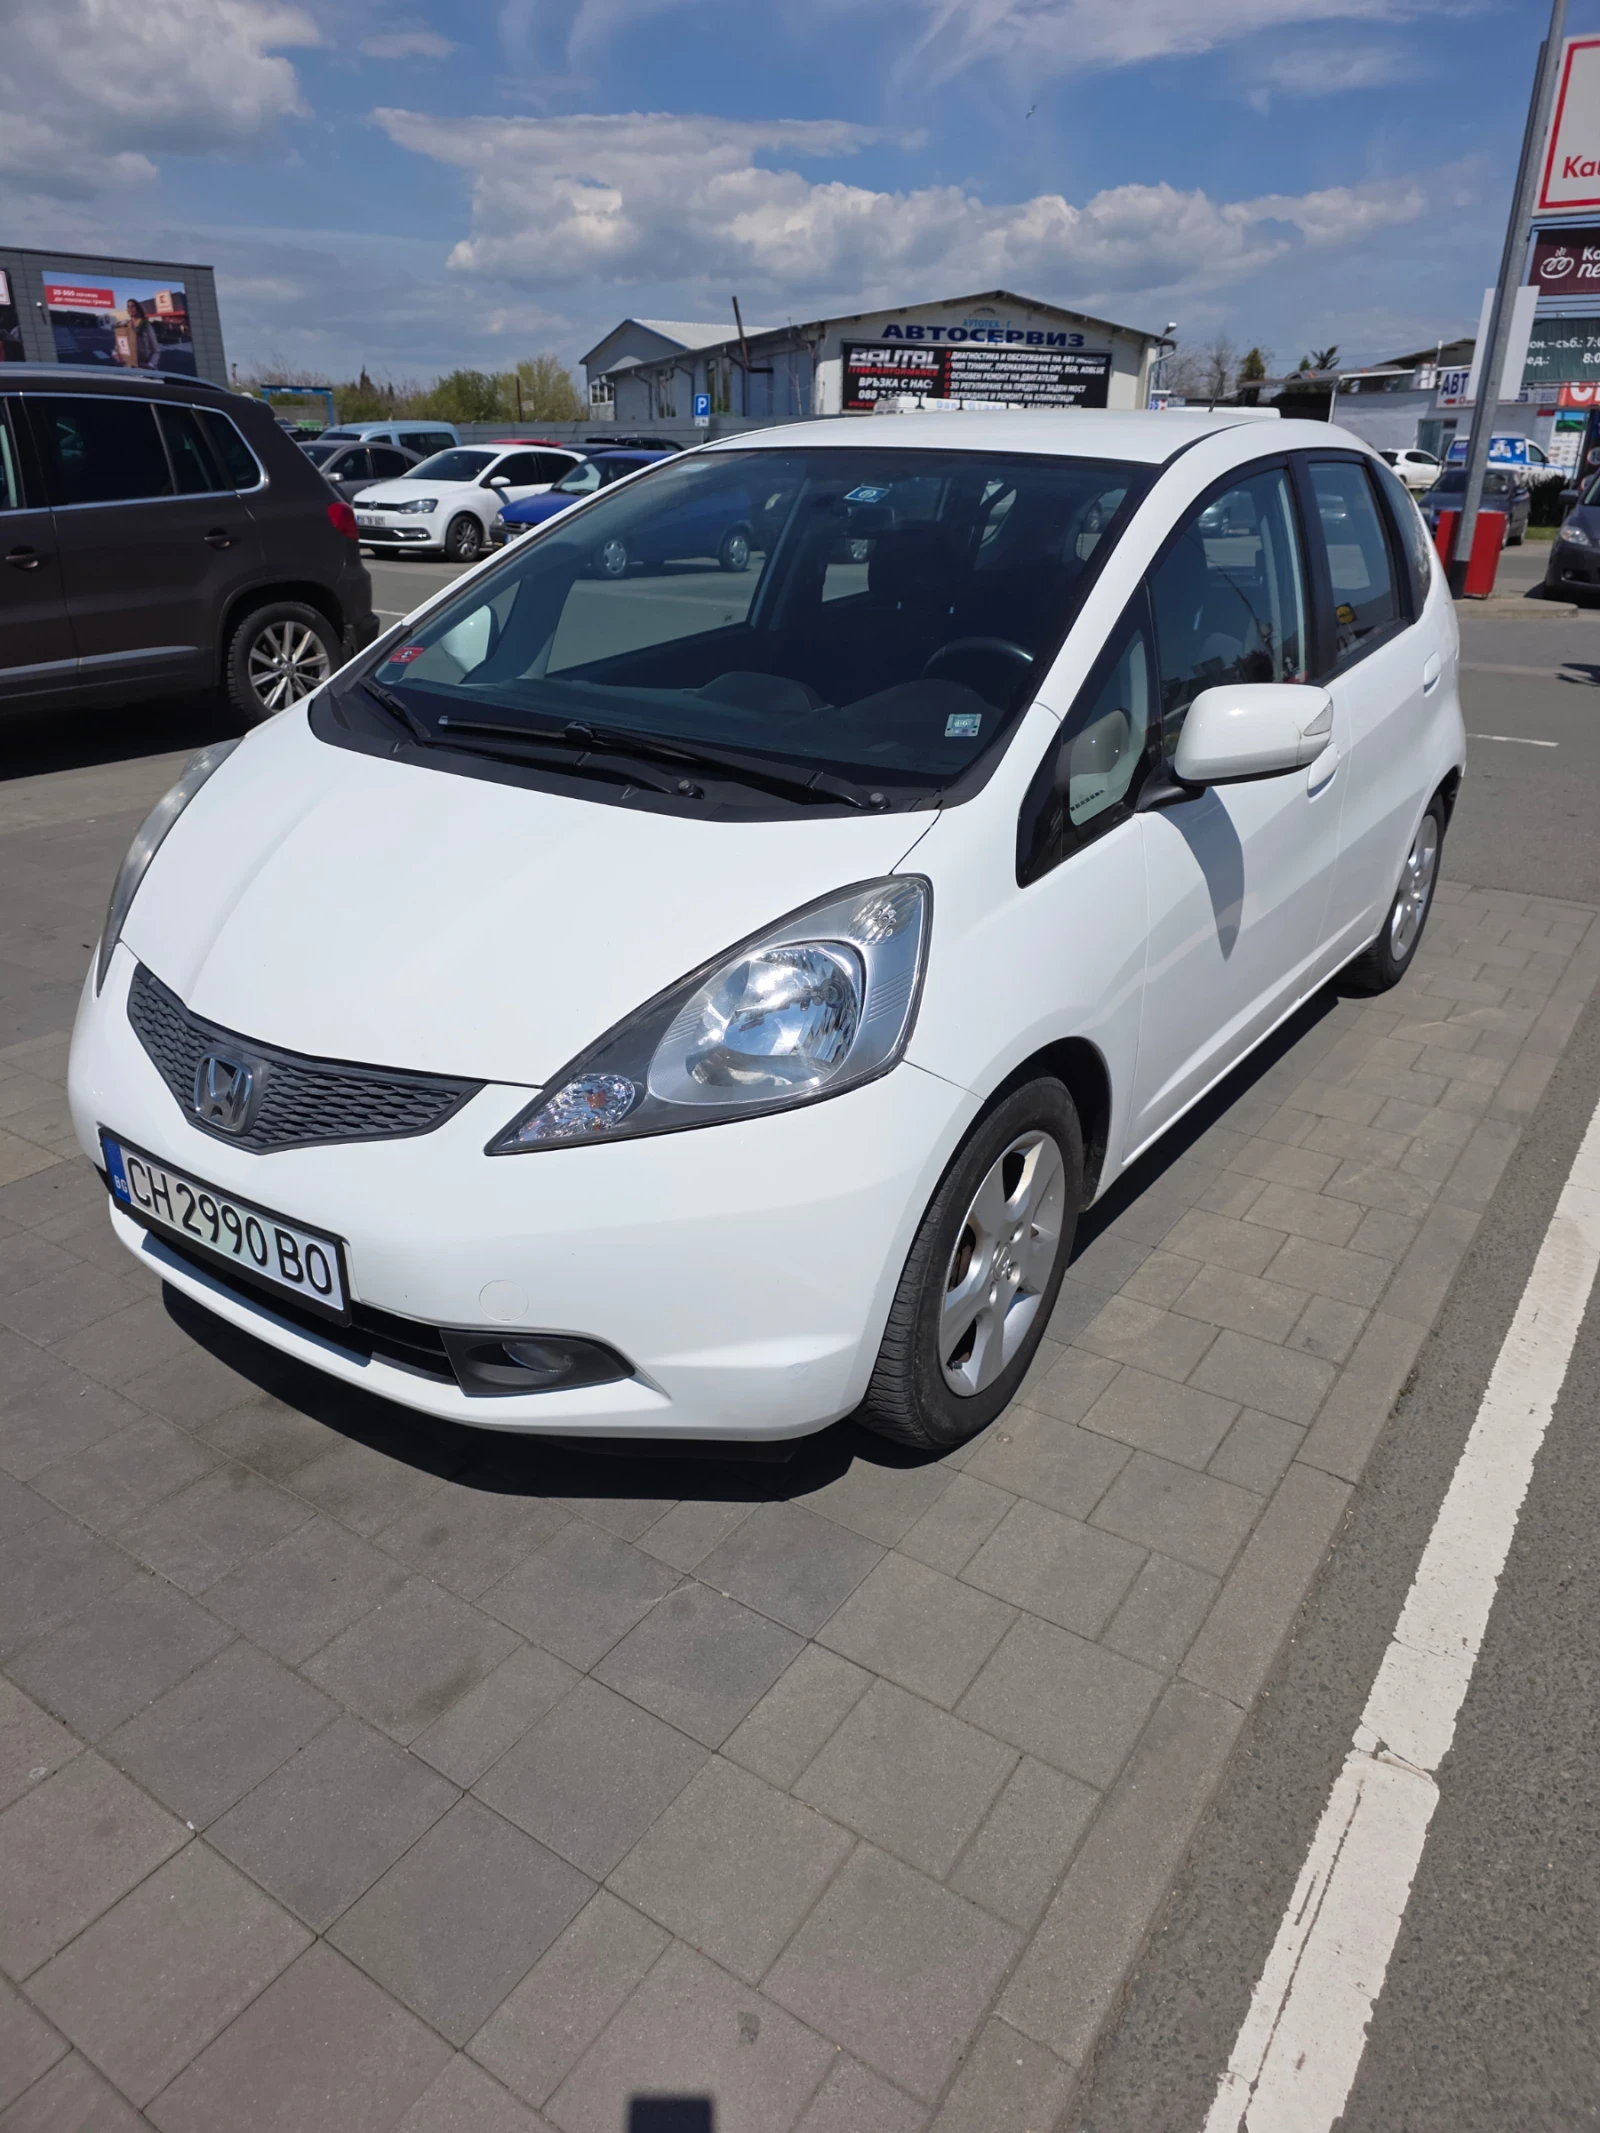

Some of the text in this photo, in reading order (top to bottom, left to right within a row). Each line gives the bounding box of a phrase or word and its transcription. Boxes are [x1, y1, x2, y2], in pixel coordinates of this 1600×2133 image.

[1562, 155, 1600, 179] Ka
[881, 324, 1085, 347] АВТОСЕРВИЗ
[849, 348, 940, 369] BRUTAL
[950, 351, 1000, 360] ДИАГНОСТИКА
[1000, 353, 1007, 361] И
[1006, 353, 1052, 362] ОБСЛУЖВАНЕ
[1526, 356, 1551, 366] ед.:
[951, 361, 966, 370] ЧИП
[995, 363, 1039, 373] ПРЕМАХВАНЕ
[1039, 364, 1048, 372] НА
[1080, 366, 1106, 375] ADBLUE
[858, 377, 934, 389] ВРЪЗКА С НАС:
[950, 371, 982, 380] ОСНОВЕН
[982, 372, 1010, 380] РЕМОНТ
[1020, 373, 1059, 382] ДВИГАТЕЛИ
[1440, 372, 1470, 395] АВТ
[960, 382, 1003, 391] РЕГУЛИРАНЕ
[1013, 383, 1039, 392] ПРЕДЕН
[1046, 384, 1068, 393] ЗАДЕН
[1068, 385, 1087, 393] МОСТ
[949, 391, 990, 400] ЗАРЕЖДАНЕ
[996, 393, 1024, 401] РЕМОНТ
[1033, 394, 1075, 403] КЛИМАТИЦИ
[697, 397, 707, 414] P
[114, 1175, 128, 1194] BG
